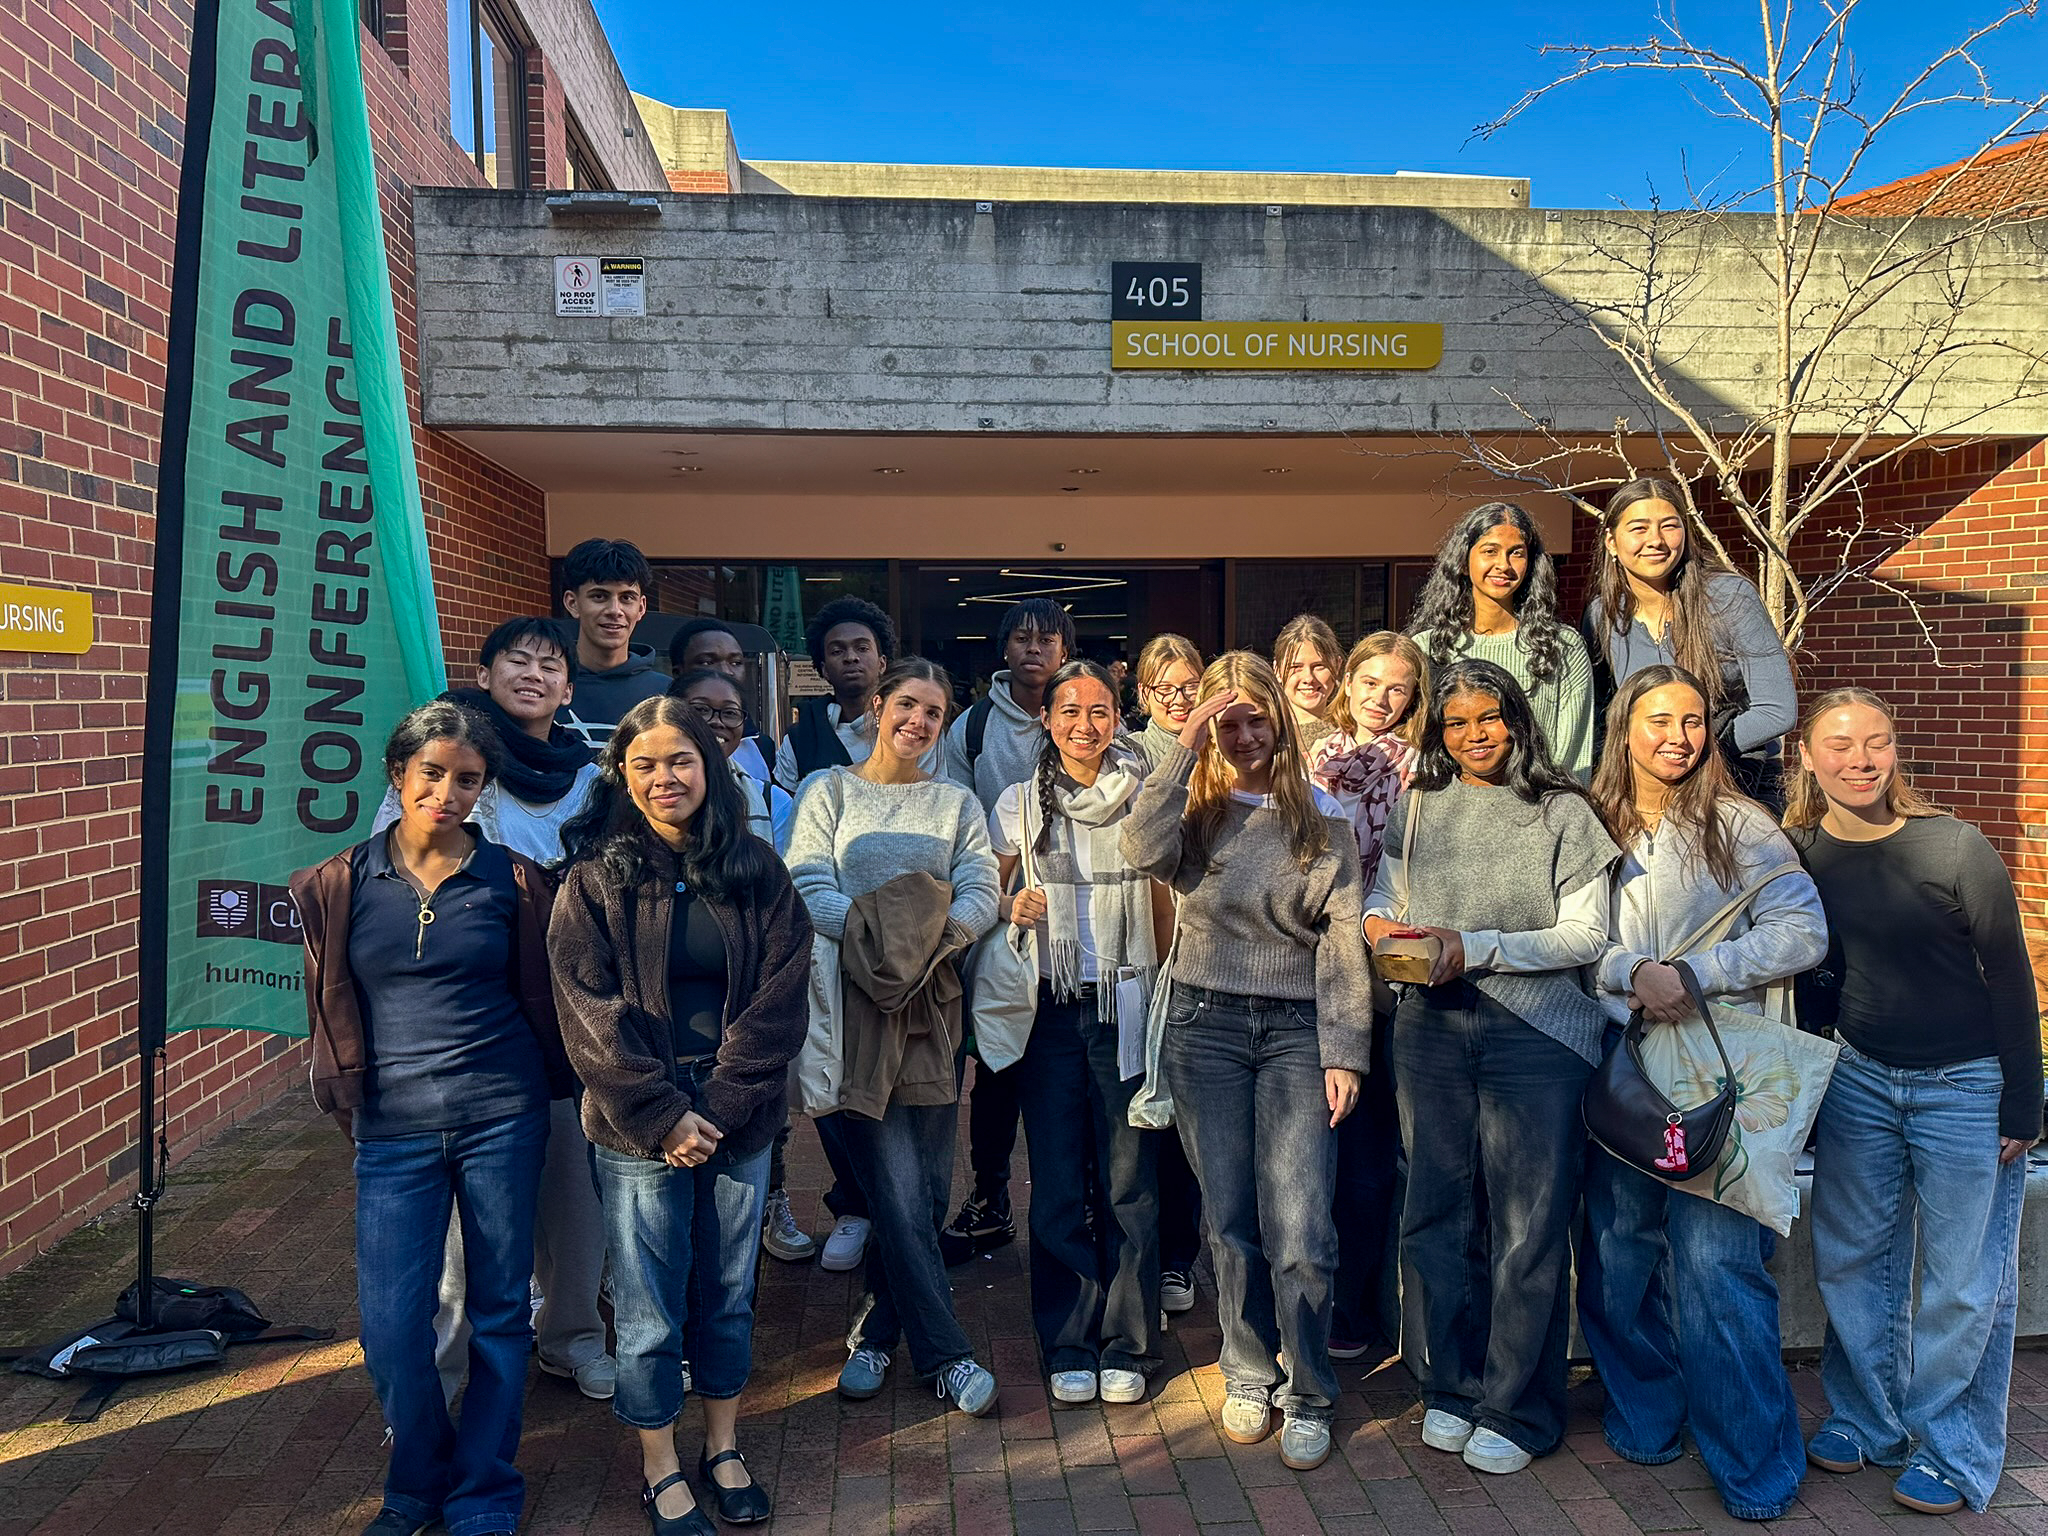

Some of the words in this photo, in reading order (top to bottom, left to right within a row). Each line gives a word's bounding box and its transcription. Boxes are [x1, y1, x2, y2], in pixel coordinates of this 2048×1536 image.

[1125, 277, 1190, 307] 405
[1126, 332, 1236, 357] SCHOOL
[1244, 332, 1279, 357] OF
[1288, 332, 1408, 357] NURSING
[225, 288, 296, 469] AND
[204, 490, 284, 826] ENGLISH
[205, 962, 305, 991] humani
